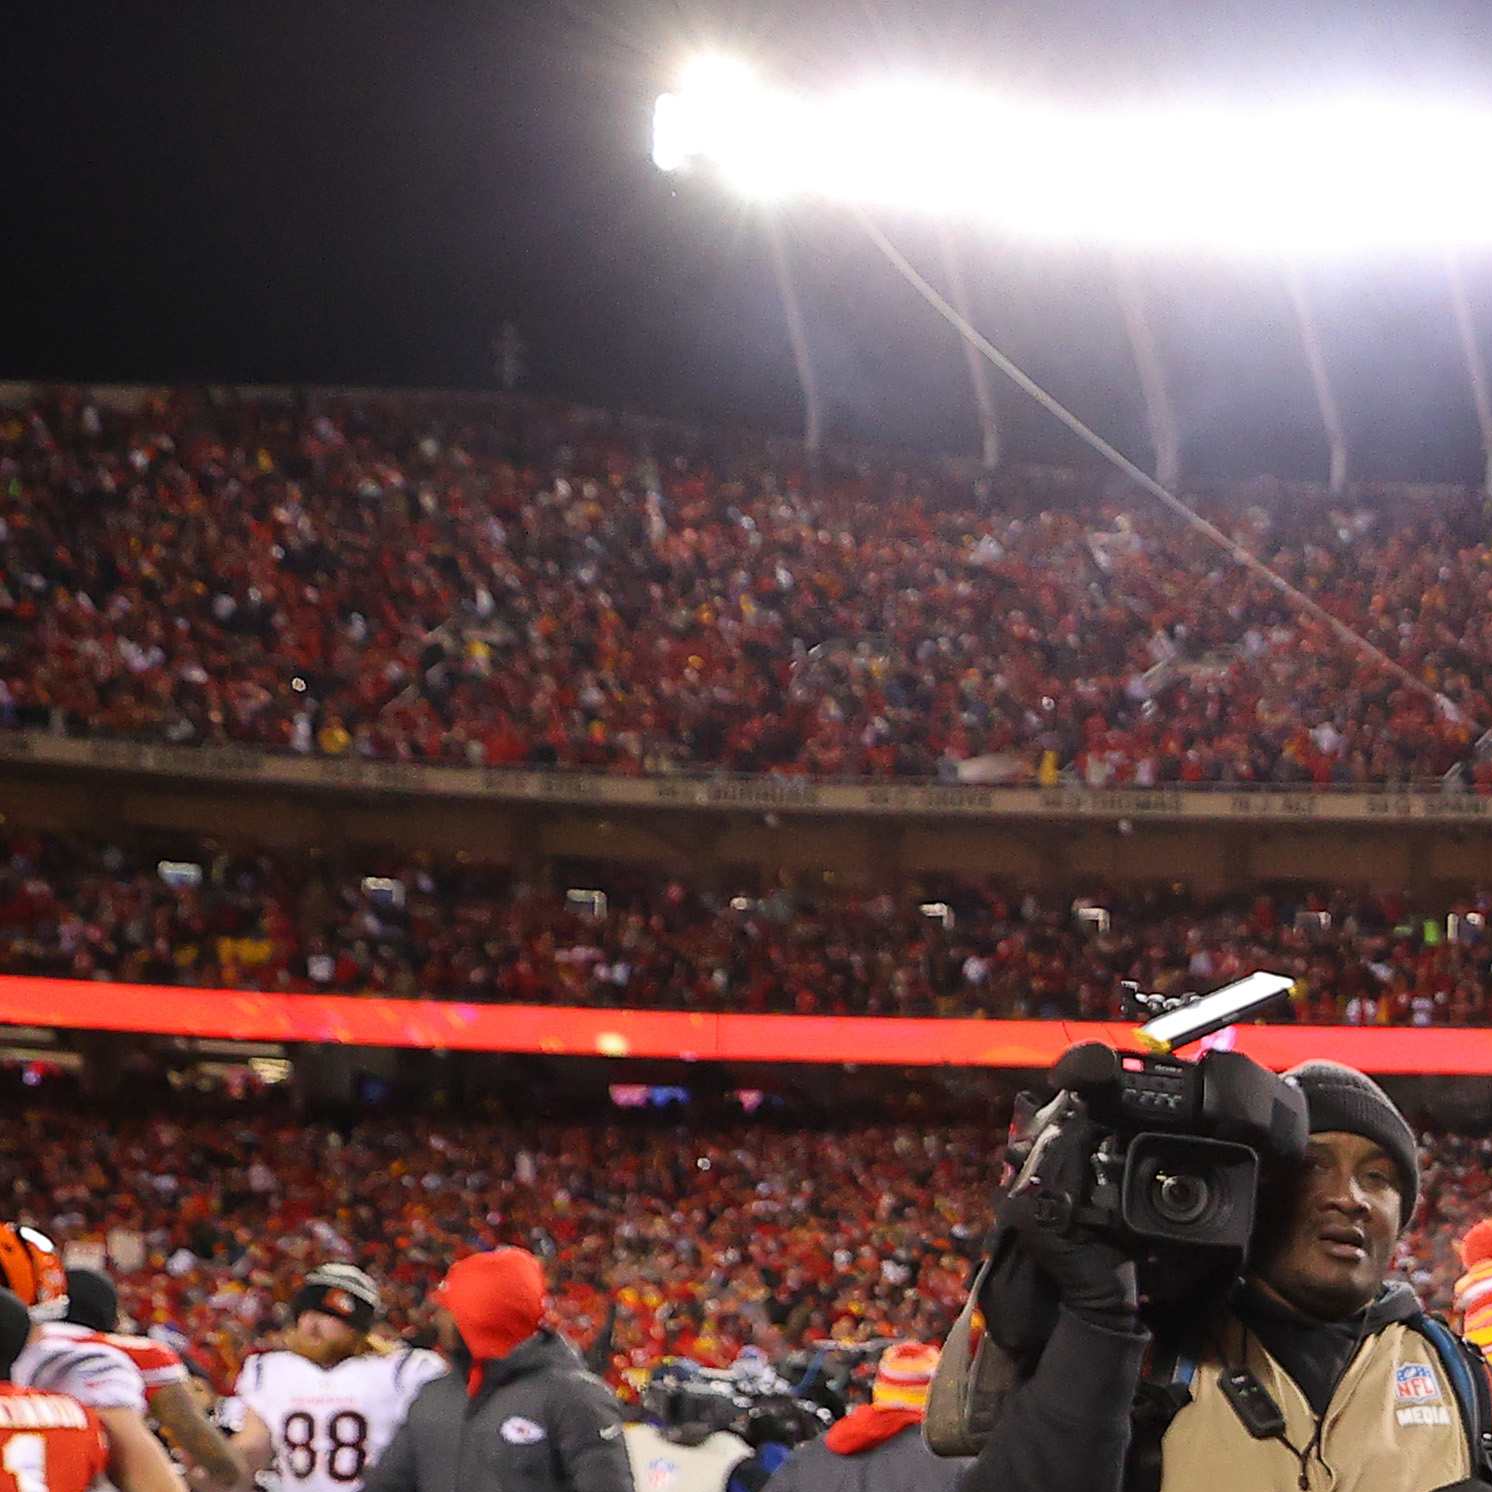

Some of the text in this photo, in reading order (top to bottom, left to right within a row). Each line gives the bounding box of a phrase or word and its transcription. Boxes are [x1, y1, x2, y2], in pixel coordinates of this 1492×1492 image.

[1397, 1377, 1434, 1398] NFL
[1396, 1405, 1451, 1427] MEDIA
[283, 1409, 368, 1482] 88
